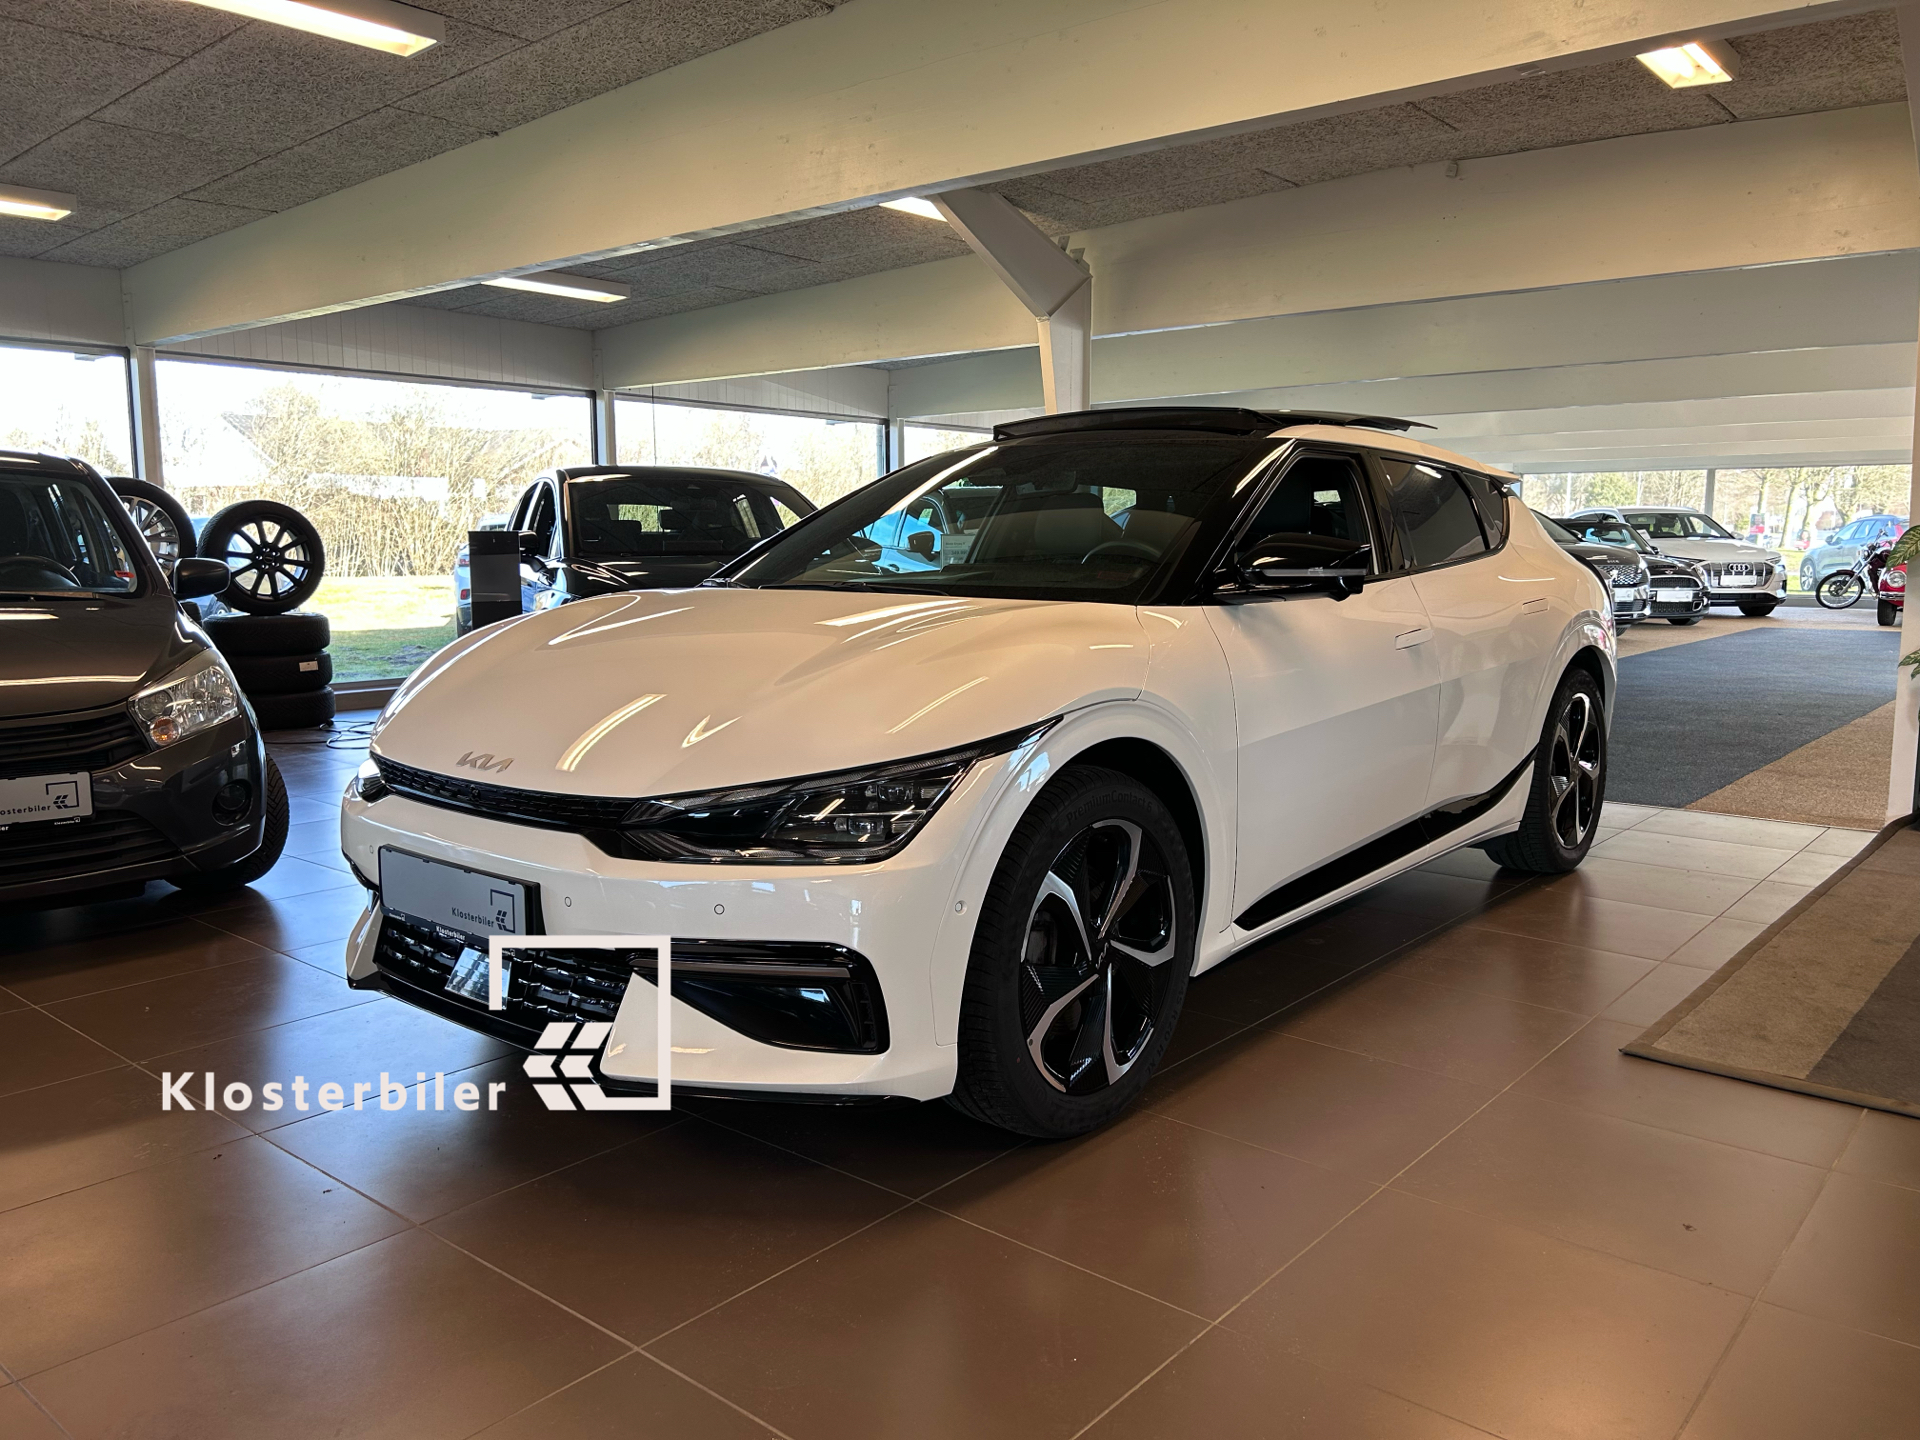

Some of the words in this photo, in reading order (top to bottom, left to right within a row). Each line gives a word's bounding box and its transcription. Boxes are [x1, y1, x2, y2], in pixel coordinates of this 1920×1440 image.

[455, 750, 515, 774] KIA
[0, 804, 51, 816] osterbiler
[1146, 802, 1154, 813] 6
[452, 906, 495, 928] Klosterbiler
